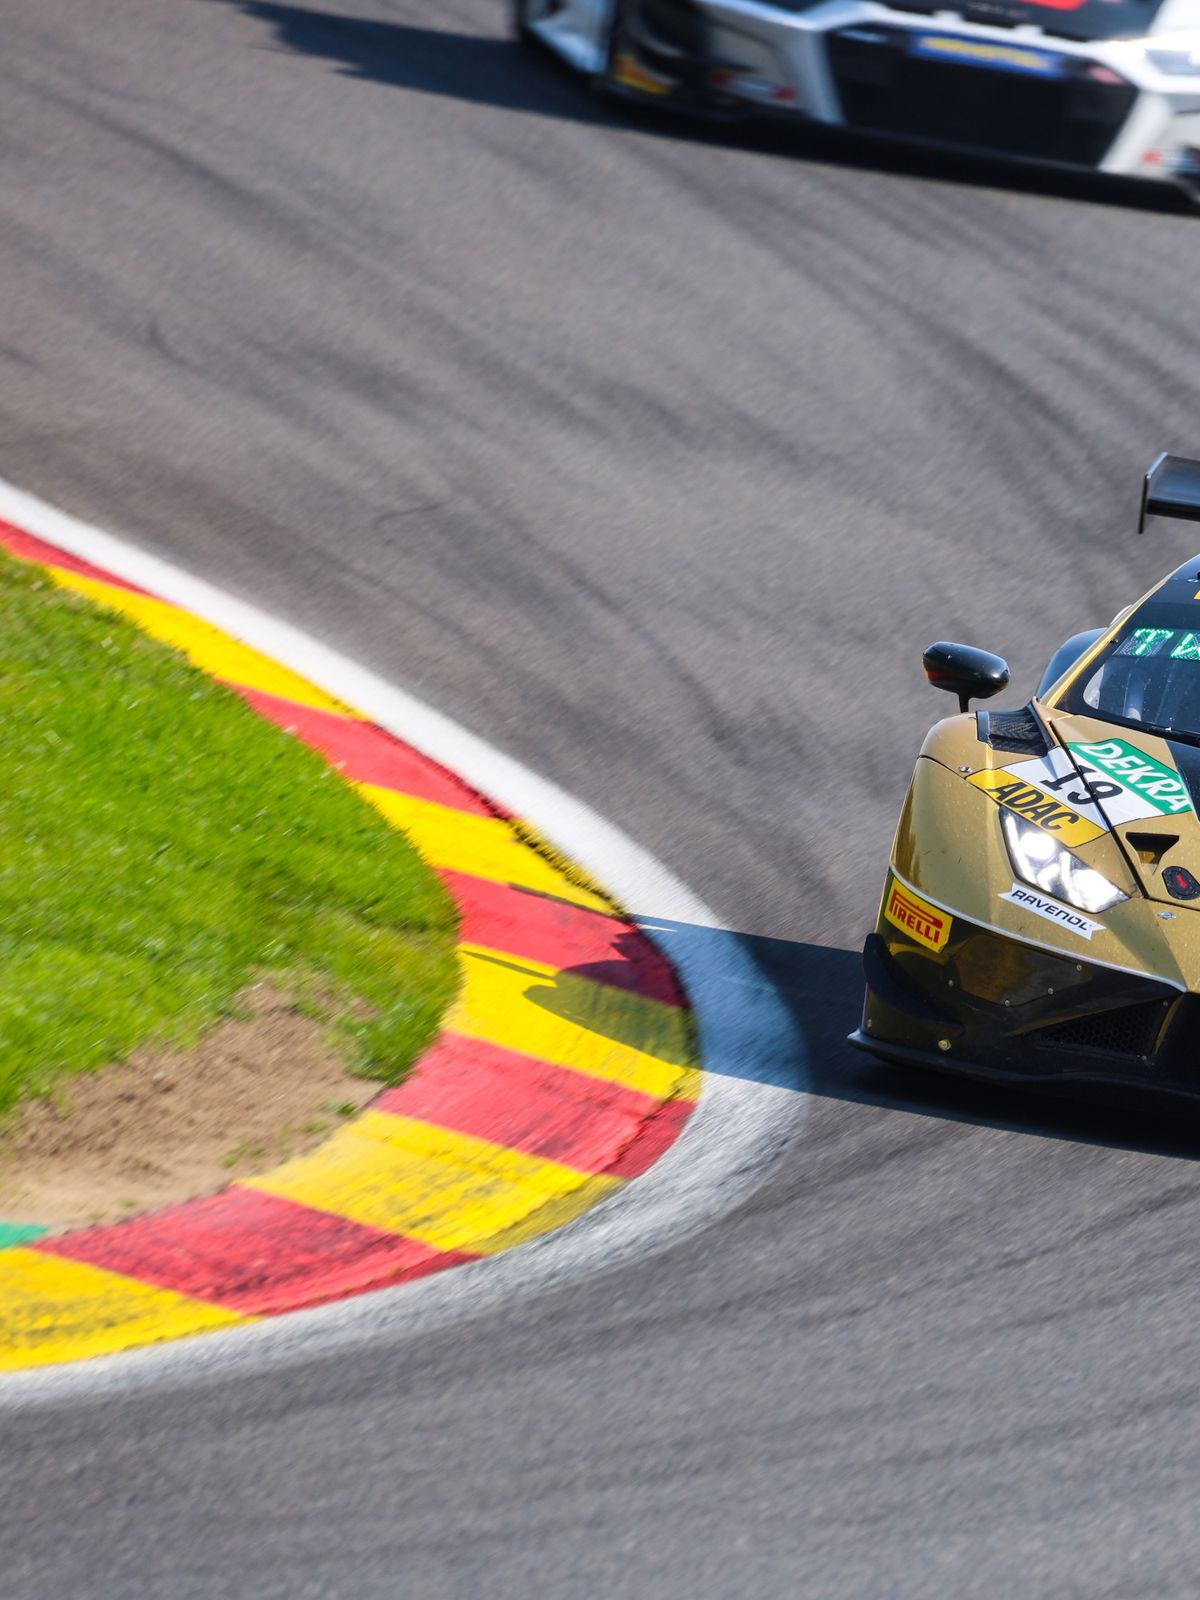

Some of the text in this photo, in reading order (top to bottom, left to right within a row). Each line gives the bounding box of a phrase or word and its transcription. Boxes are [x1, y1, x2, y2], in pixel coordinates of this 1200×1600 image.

[1040, 765, 1123, 805] 19
[1076, 742, 1191, 812] DEKRA
[987, 781, 1080, 831] ADAC
[888, 888, 944, 944] PIRELLI
[1011, 889, 1088, 931] RAVENOL
